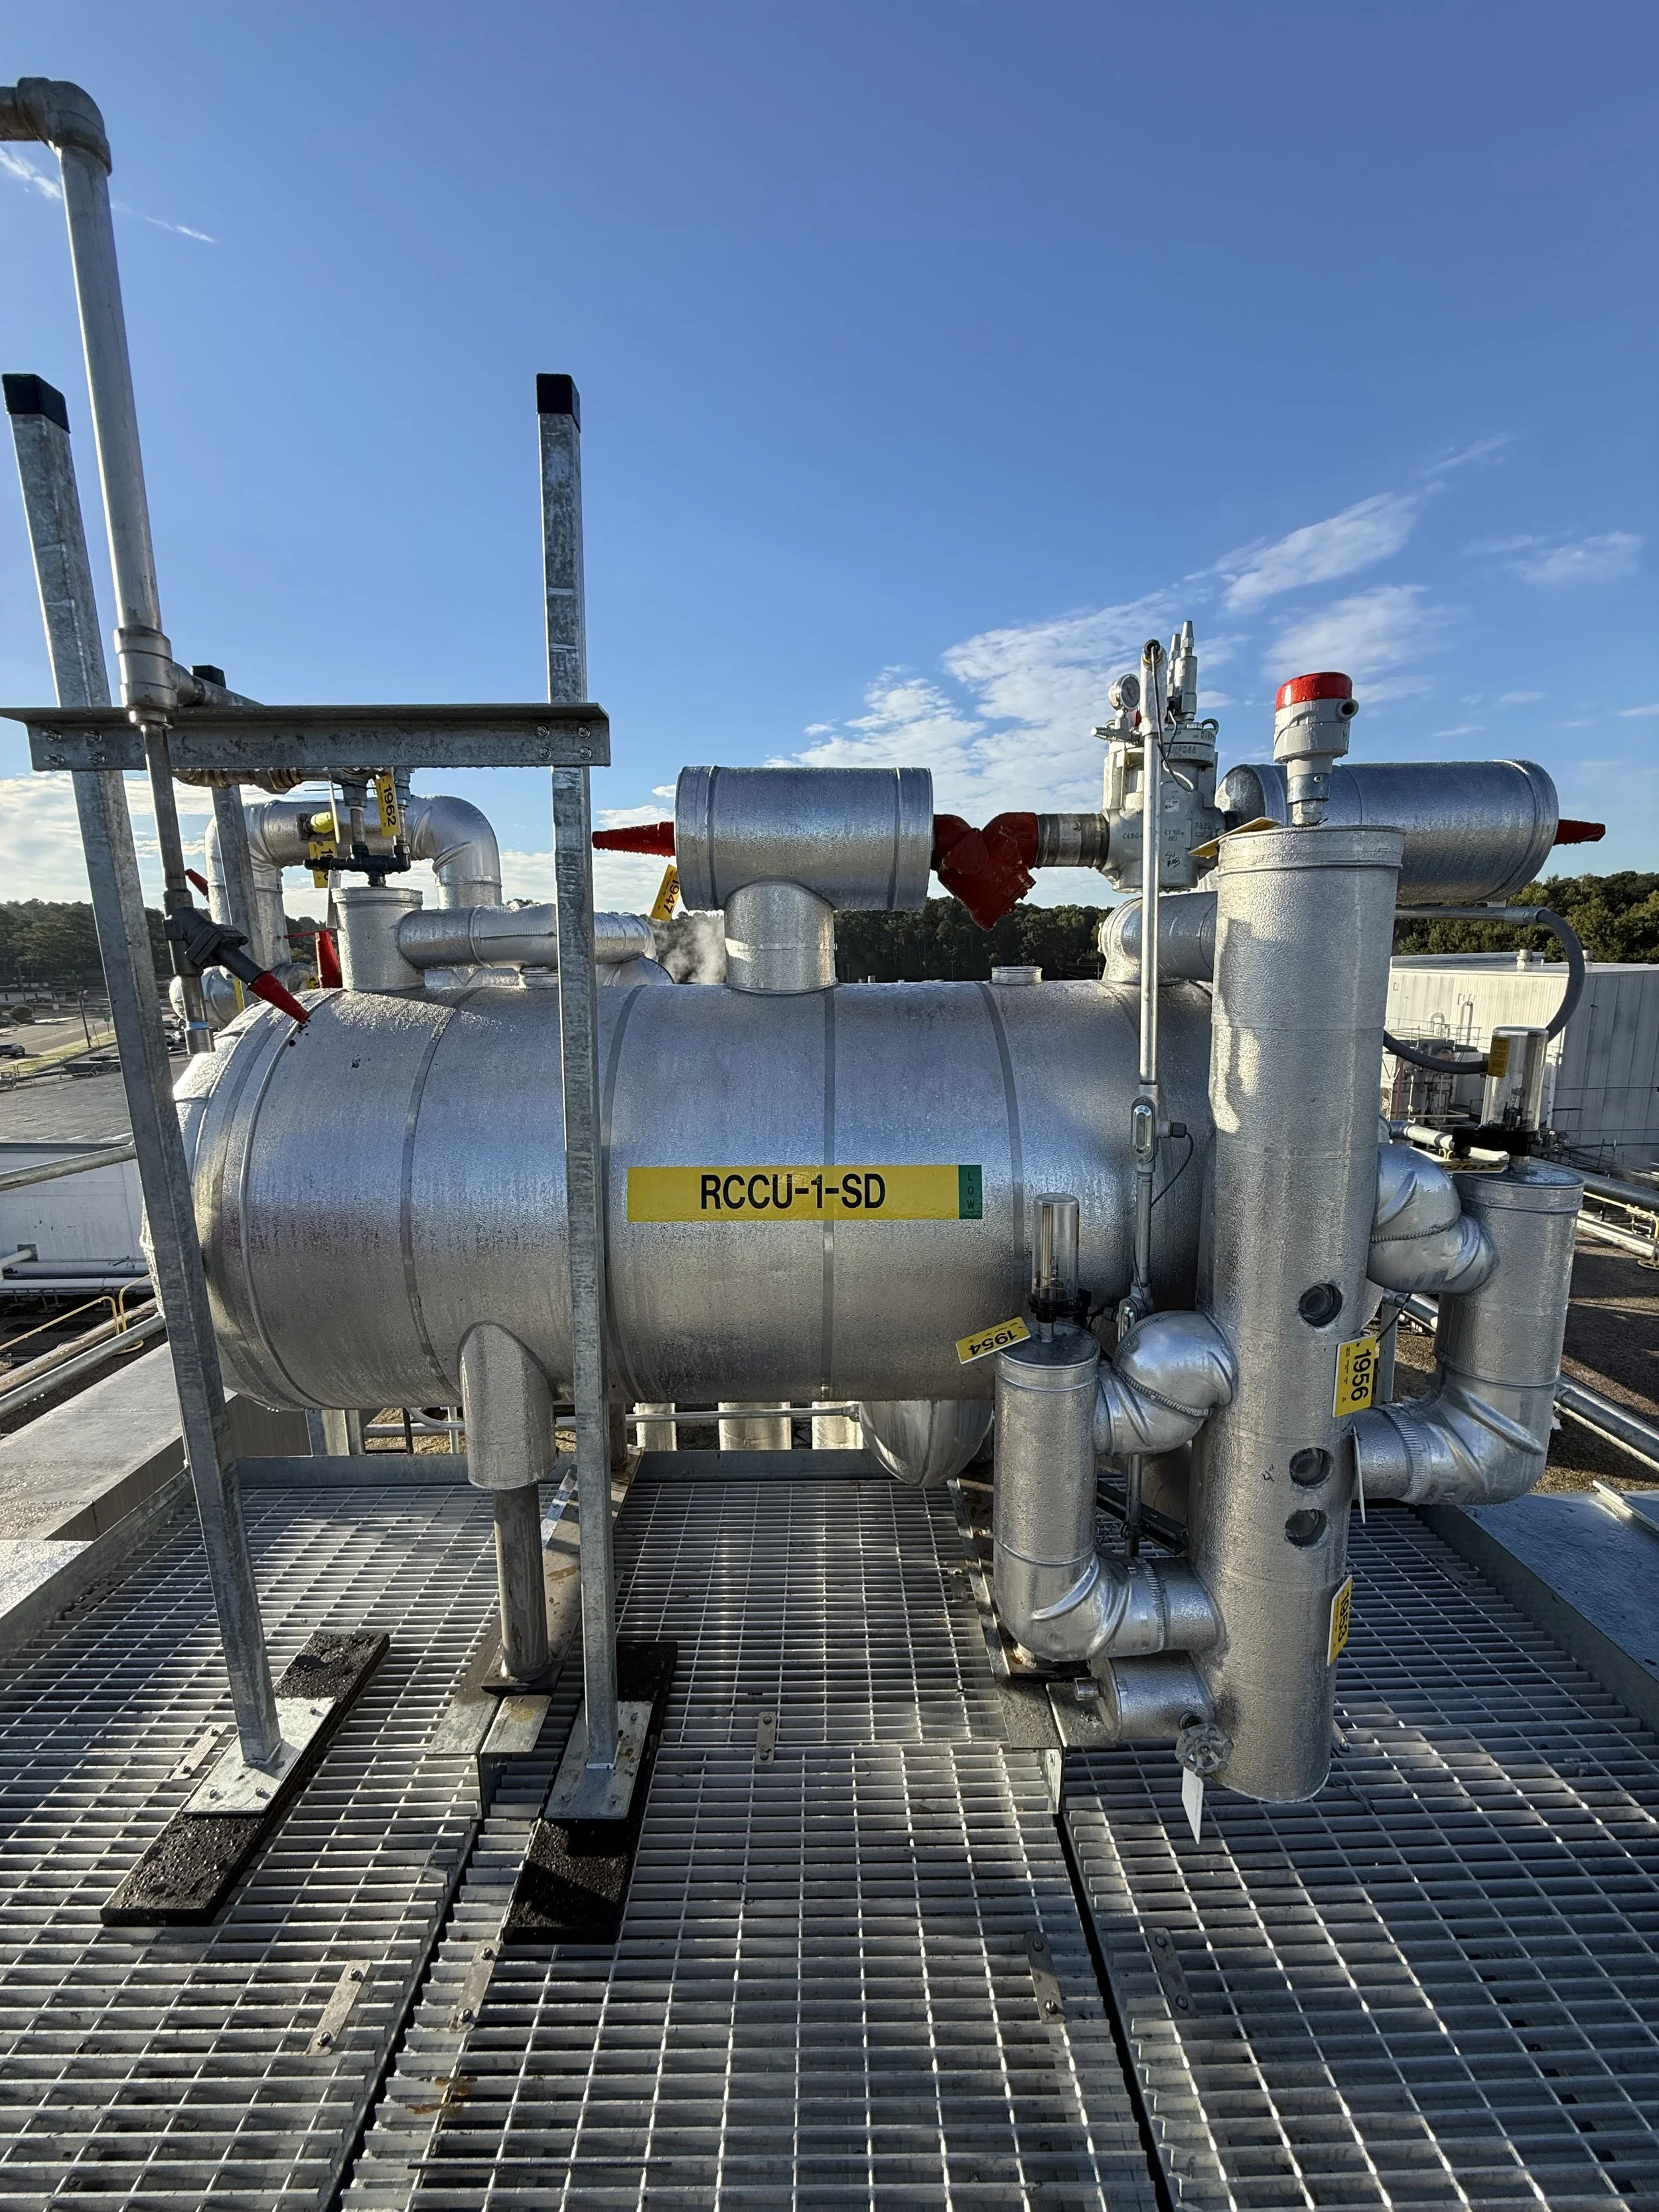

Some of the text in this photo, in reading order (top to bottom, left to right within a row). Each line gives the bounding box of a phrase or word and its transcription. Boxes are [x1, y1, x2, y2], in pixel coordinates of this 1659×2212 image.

[384, 784, 397, 827] 1962
[664, 879, 680, 914] 1947
[701, 1173, 886, 1210] RCCU-1-SD
[966, 1171, 975, 1209] LOW
[968, 1329, 1018, 1356] 1954
[1350, 1348, 1372, 1402] 1956
[1338, 1591, 1350, 1643] 1953
